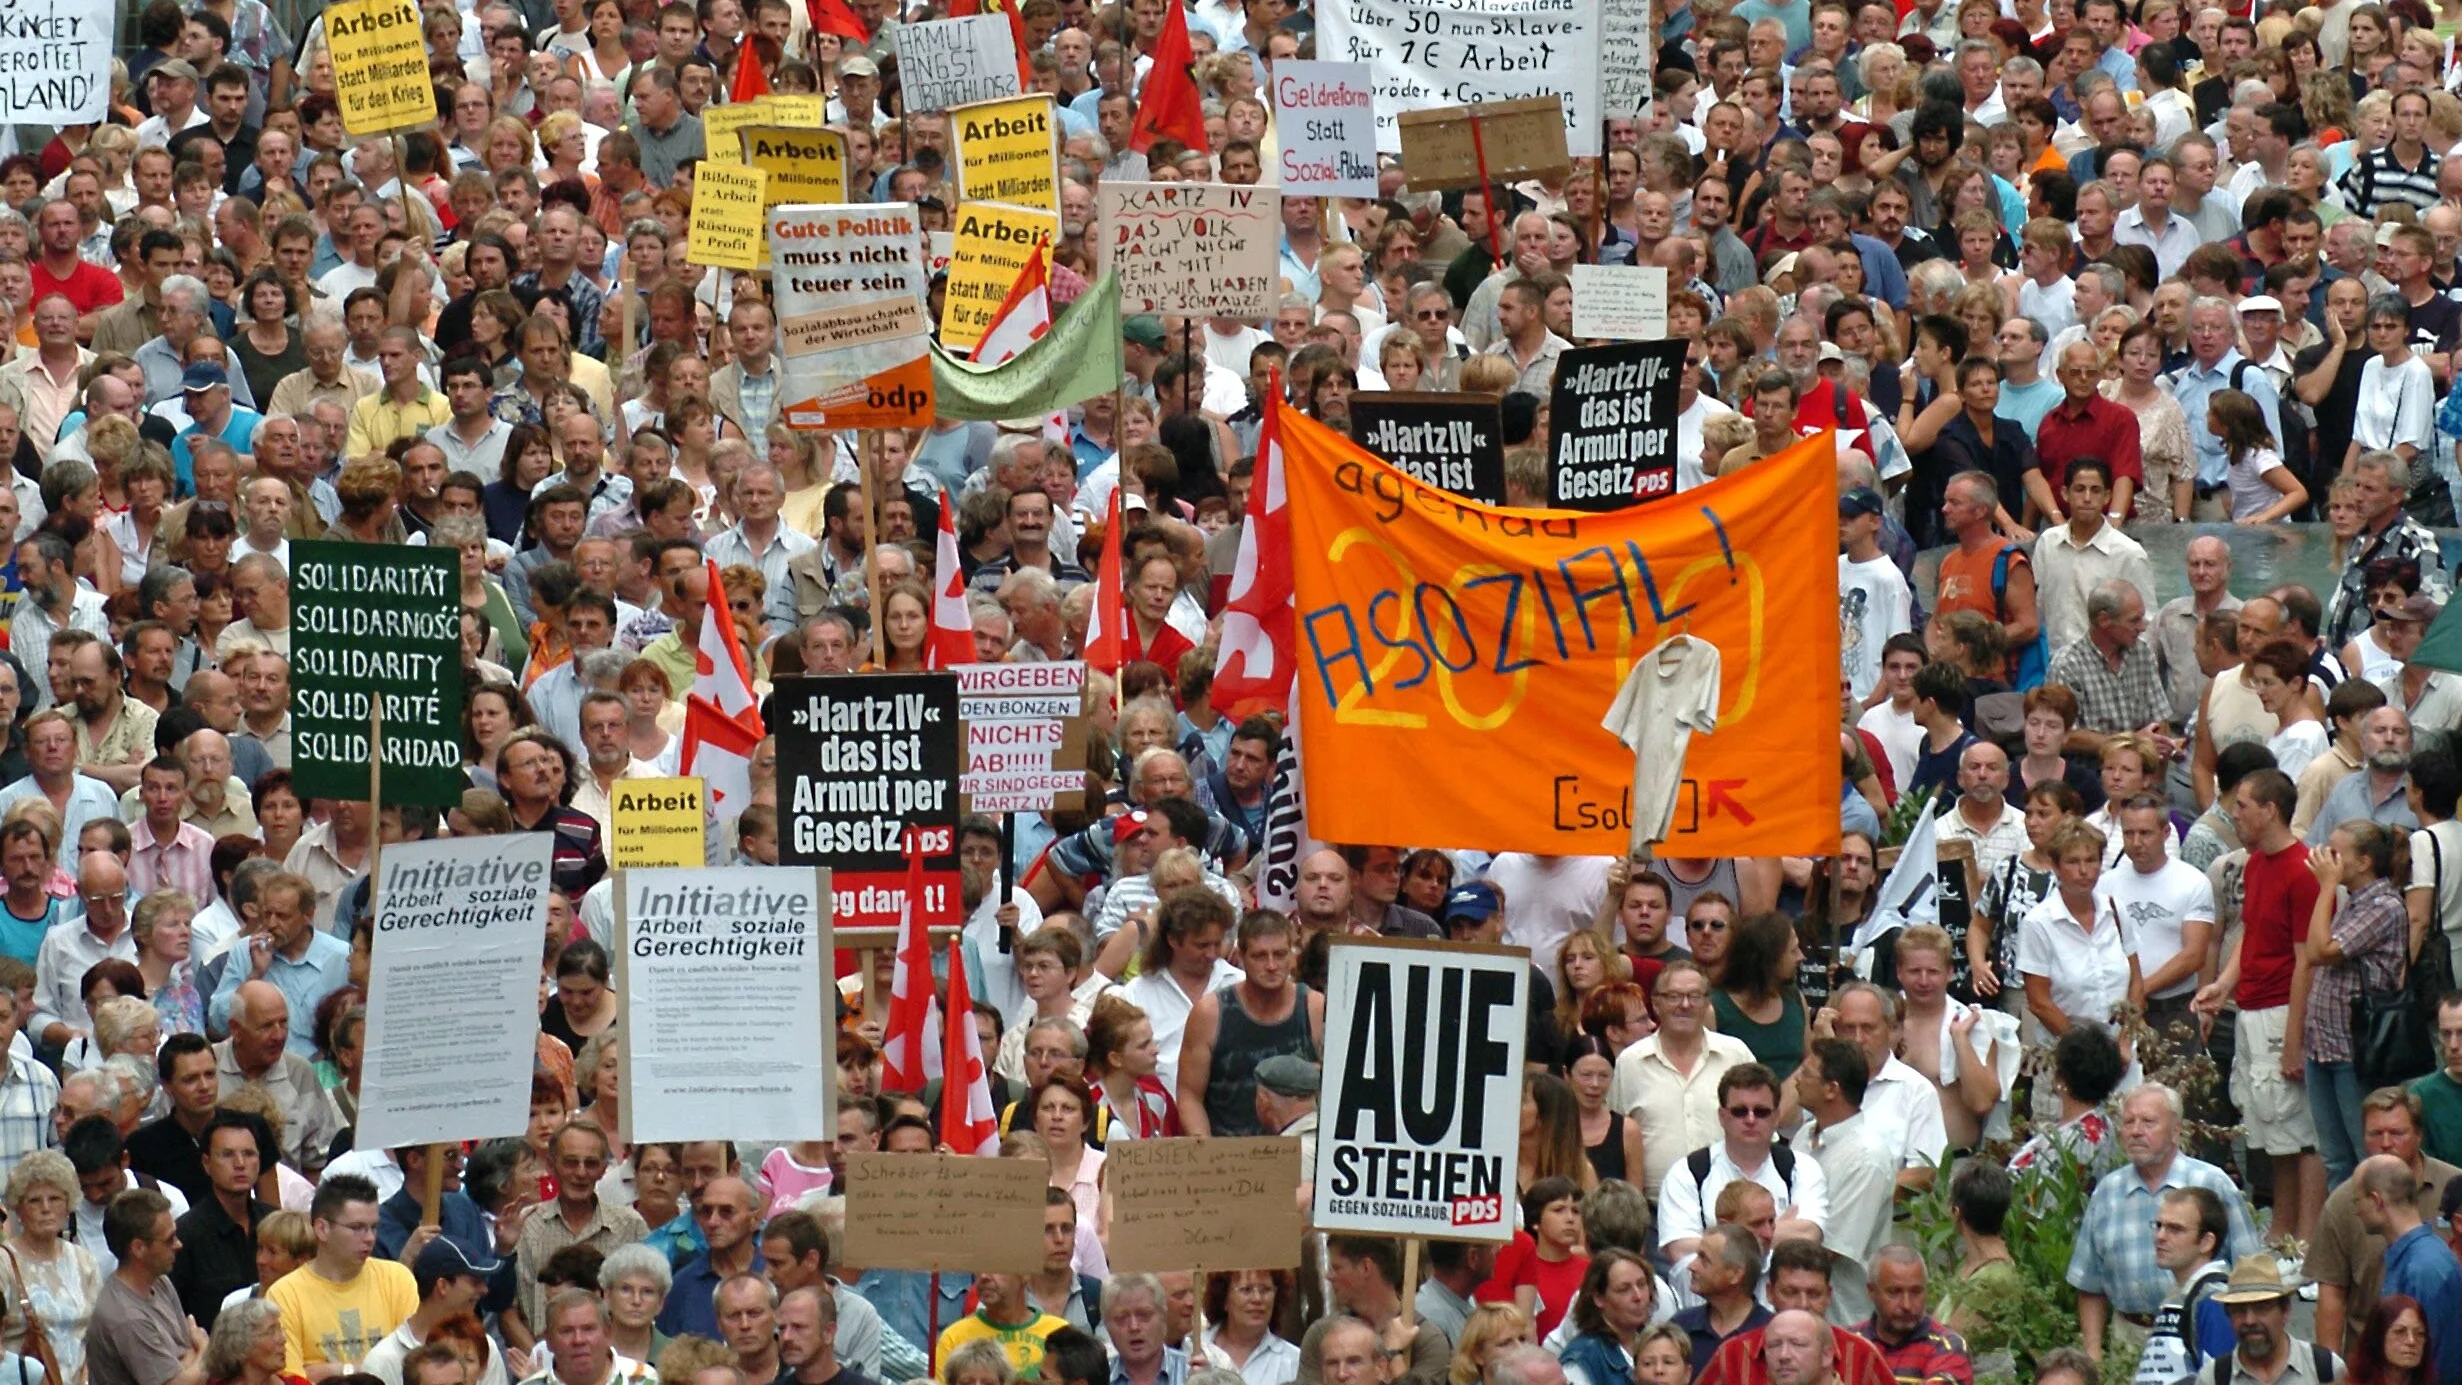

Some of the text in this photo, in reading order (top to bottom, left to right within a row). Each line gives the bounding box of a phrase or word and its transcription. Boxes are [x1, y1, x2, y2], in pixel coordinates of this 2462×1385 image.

[332, 4, 414, 37] Arbeit
[1404, 11, 1440, 34] 50
[1452, 24, 1485, 37] nun
[1490, 11, 1583, 37] Sklave-
[896, 18, 976, 55] ARMUT
[335, 39, 419, 62] für Millionen
[1348, 36, 1384, 62] für
[1460, 41, 1554, 71] Arbeit
[339, 59, 425, 88] statt Milliarden
[901, 49, 977, 85] ANGST
[349, 84, 424, 111] für den Krieg
[1279, 76, 1370, 108] Geldreform
[1441, 88, 1452, 101] +
[963, 112, 1047, 142] Arbeit
[755, 140, 837, 161] Arbeit
[964, 148, 1049, 167] für Millionen
[1283, 149, 1374, 182] Sozial-Abbau
[701, 171, 757, 189] Bildung
[777, 172, 839, 186] Millionen
[967, 175, 1051, 200] statt Milliarden
[712, 188, 757, 202] Arbeit
[1229, 189, 1253, 208] IV
[700, 206, 724, 216] statt
[696, 219, 754, 237] Rüstung
[775, 217, 913, 239] Gute Politik
[1114, 217, 1236, 245] DAS VOLK
[707, 236, 747, 250] Profit
[784, 245, 909, 265] muss nicht
[1114, 238, 1247, 263] MACHT NICHT
[955, 250, 975, 263] für
[792, 273, 905, 293] teuer sein
[951, 281, 979, 299] statt
[1120, 276, 1268, 299] ENN WIR HABEN
[953, 304, 971, 323] für
[1143, 295, 1261, 312] DIE SCHNAUZE
[784, 304, 916, 337] Sozialabbau schadet
[805, 319, 900, 345] der Wirtschaft
[866, 384, 927, 415] ödp
[1580, 392, 1652, 429] das ist
[1559, 426, 1669, 466] Armut per
[1440, 456, 1474, 490] ist
[1558, 463, 1669, 500] Gesetz PDS
[297, 563, 448, 597] SOLIDARITÄT
[297, 648, 442, 682] SOLIDARITY
[961, 701, 1070, 715] DEN BONZEN
[970, 723, 1063, 744] NICHTS
[298, 731, 460, 768] SOLIDRIDAD
[821, 734, 922, 773] das ist
[792, 775, 947, 815] Armut per
[960, 779, 980, 792] IR
[618, 792, 696, 812] Arbeit
[975, 796, 1051, 809] HARTZ IV
[618, 825, 698, 836] für Millionen
[793, 815, 902, 853] Gesetz
[618, 845, 644, 853] statt
[387, 856, 543, 890] Initiative
[618, 859, 680, 868] Milliarden
[384, 884, 536, 911] Arbeit soziale
[637, 885, 808, 917] Initiative
[380, 904, 534, 931] Gerechtigkeit
[636, 918, 805, 935] Arbeit soziale
[634, 937, 805, 960] Gerechtigkeit
[1334, 961, 1515, 1149] AUF
[1117, 1143, 1199, 1166] MEISTER
[1331, 1145, 1502, 1203] STEHEN
[1329, 1200, 1370, 1216] GEGEN
[1455, 1198, 1498, 1222] PDS
